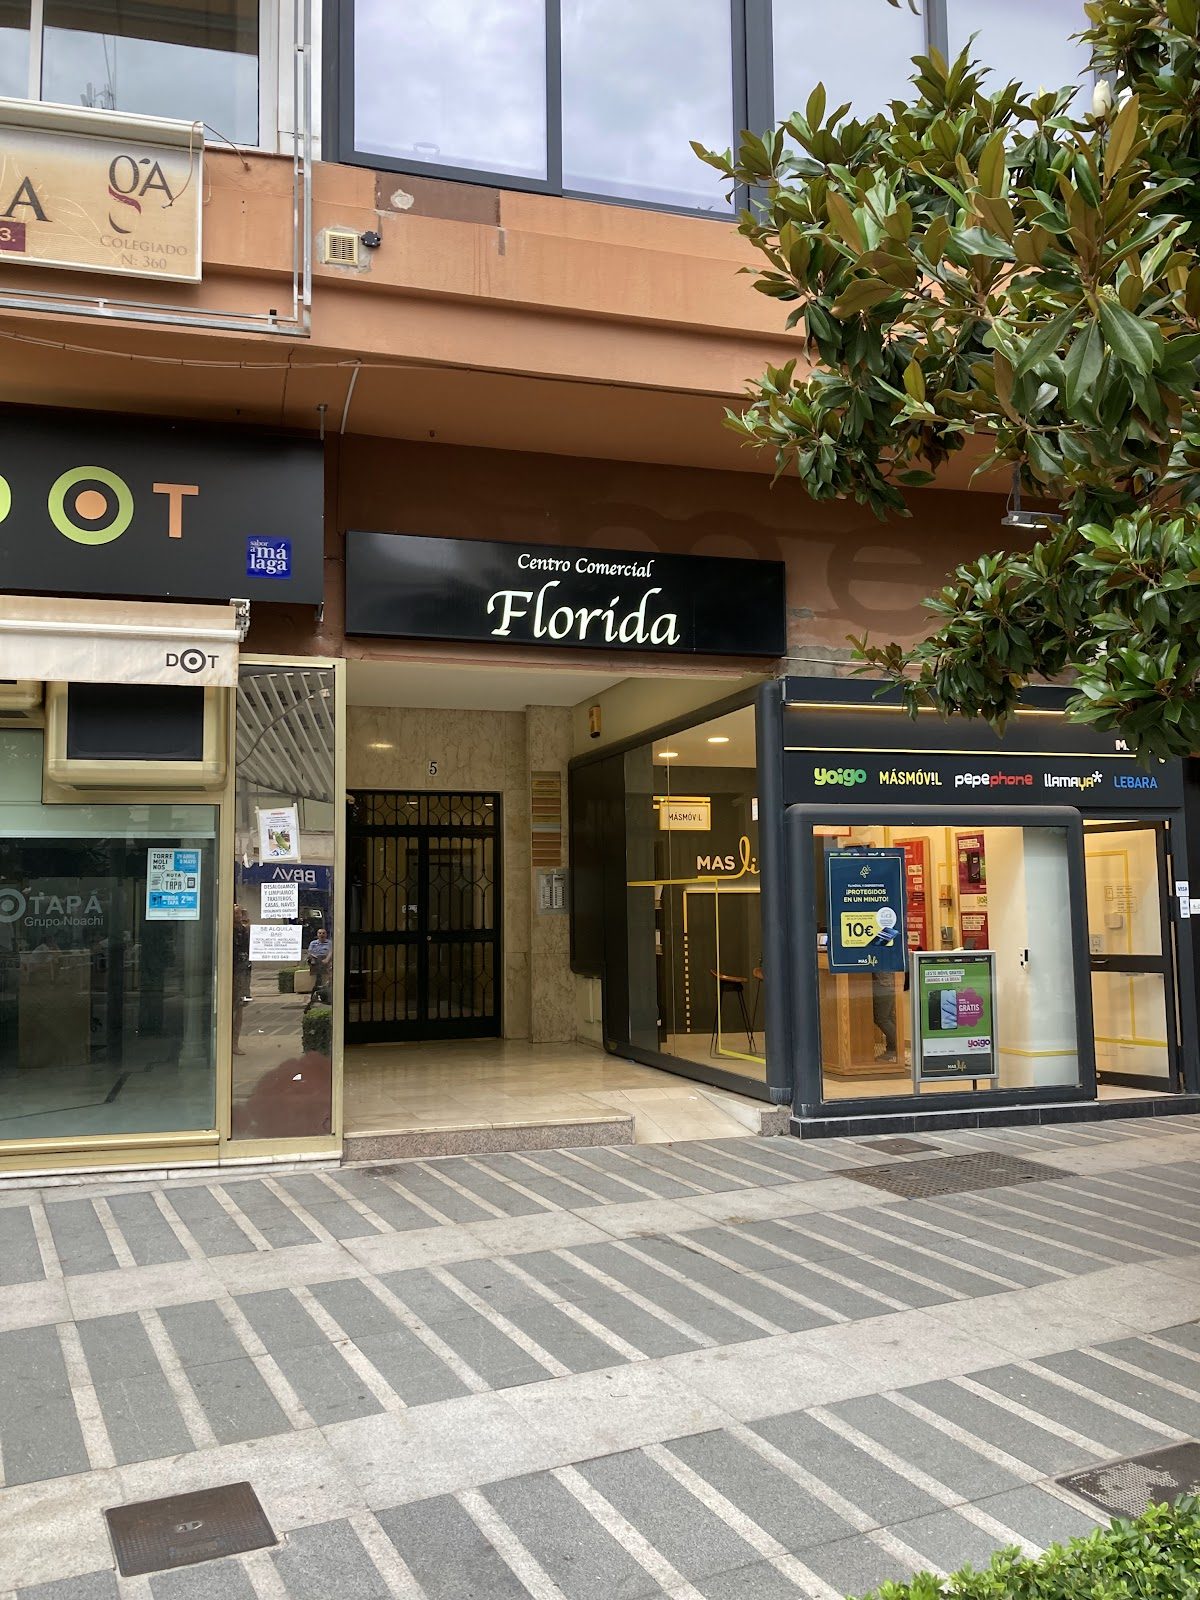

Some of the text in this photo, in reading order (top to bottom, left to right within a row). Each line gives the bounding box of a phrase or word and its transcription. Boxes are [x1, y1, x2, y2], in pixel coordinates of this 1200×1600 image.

[100, 235, 188, 256] COLEGIADO
[143, 256, 167, 270] 360
[0, 466, 199, 546] OT
[250, 554, 288, 574] laga
[517, 553, 655, 578] Centro Comercial
[486, 580, 680, 646] Florida
[166, 649, 219, 674] DOT
[430, 762, 438, 775] 5
[814, 768, 866, 786] yoigo
[954, 771, 1033, 788] pepephone
[1114, 776, 1158, 788] LEBARA
[696, 855, 736, 870] MAS
[165, 880, 182, 890] TAPA
[24, 916, 104, 928] Grupo Noachi
[846, 922, 874, 938] 10€
[958, 1004, 980, 1012] GRATIS
[968, 1039, 990, 1048] yoigo
